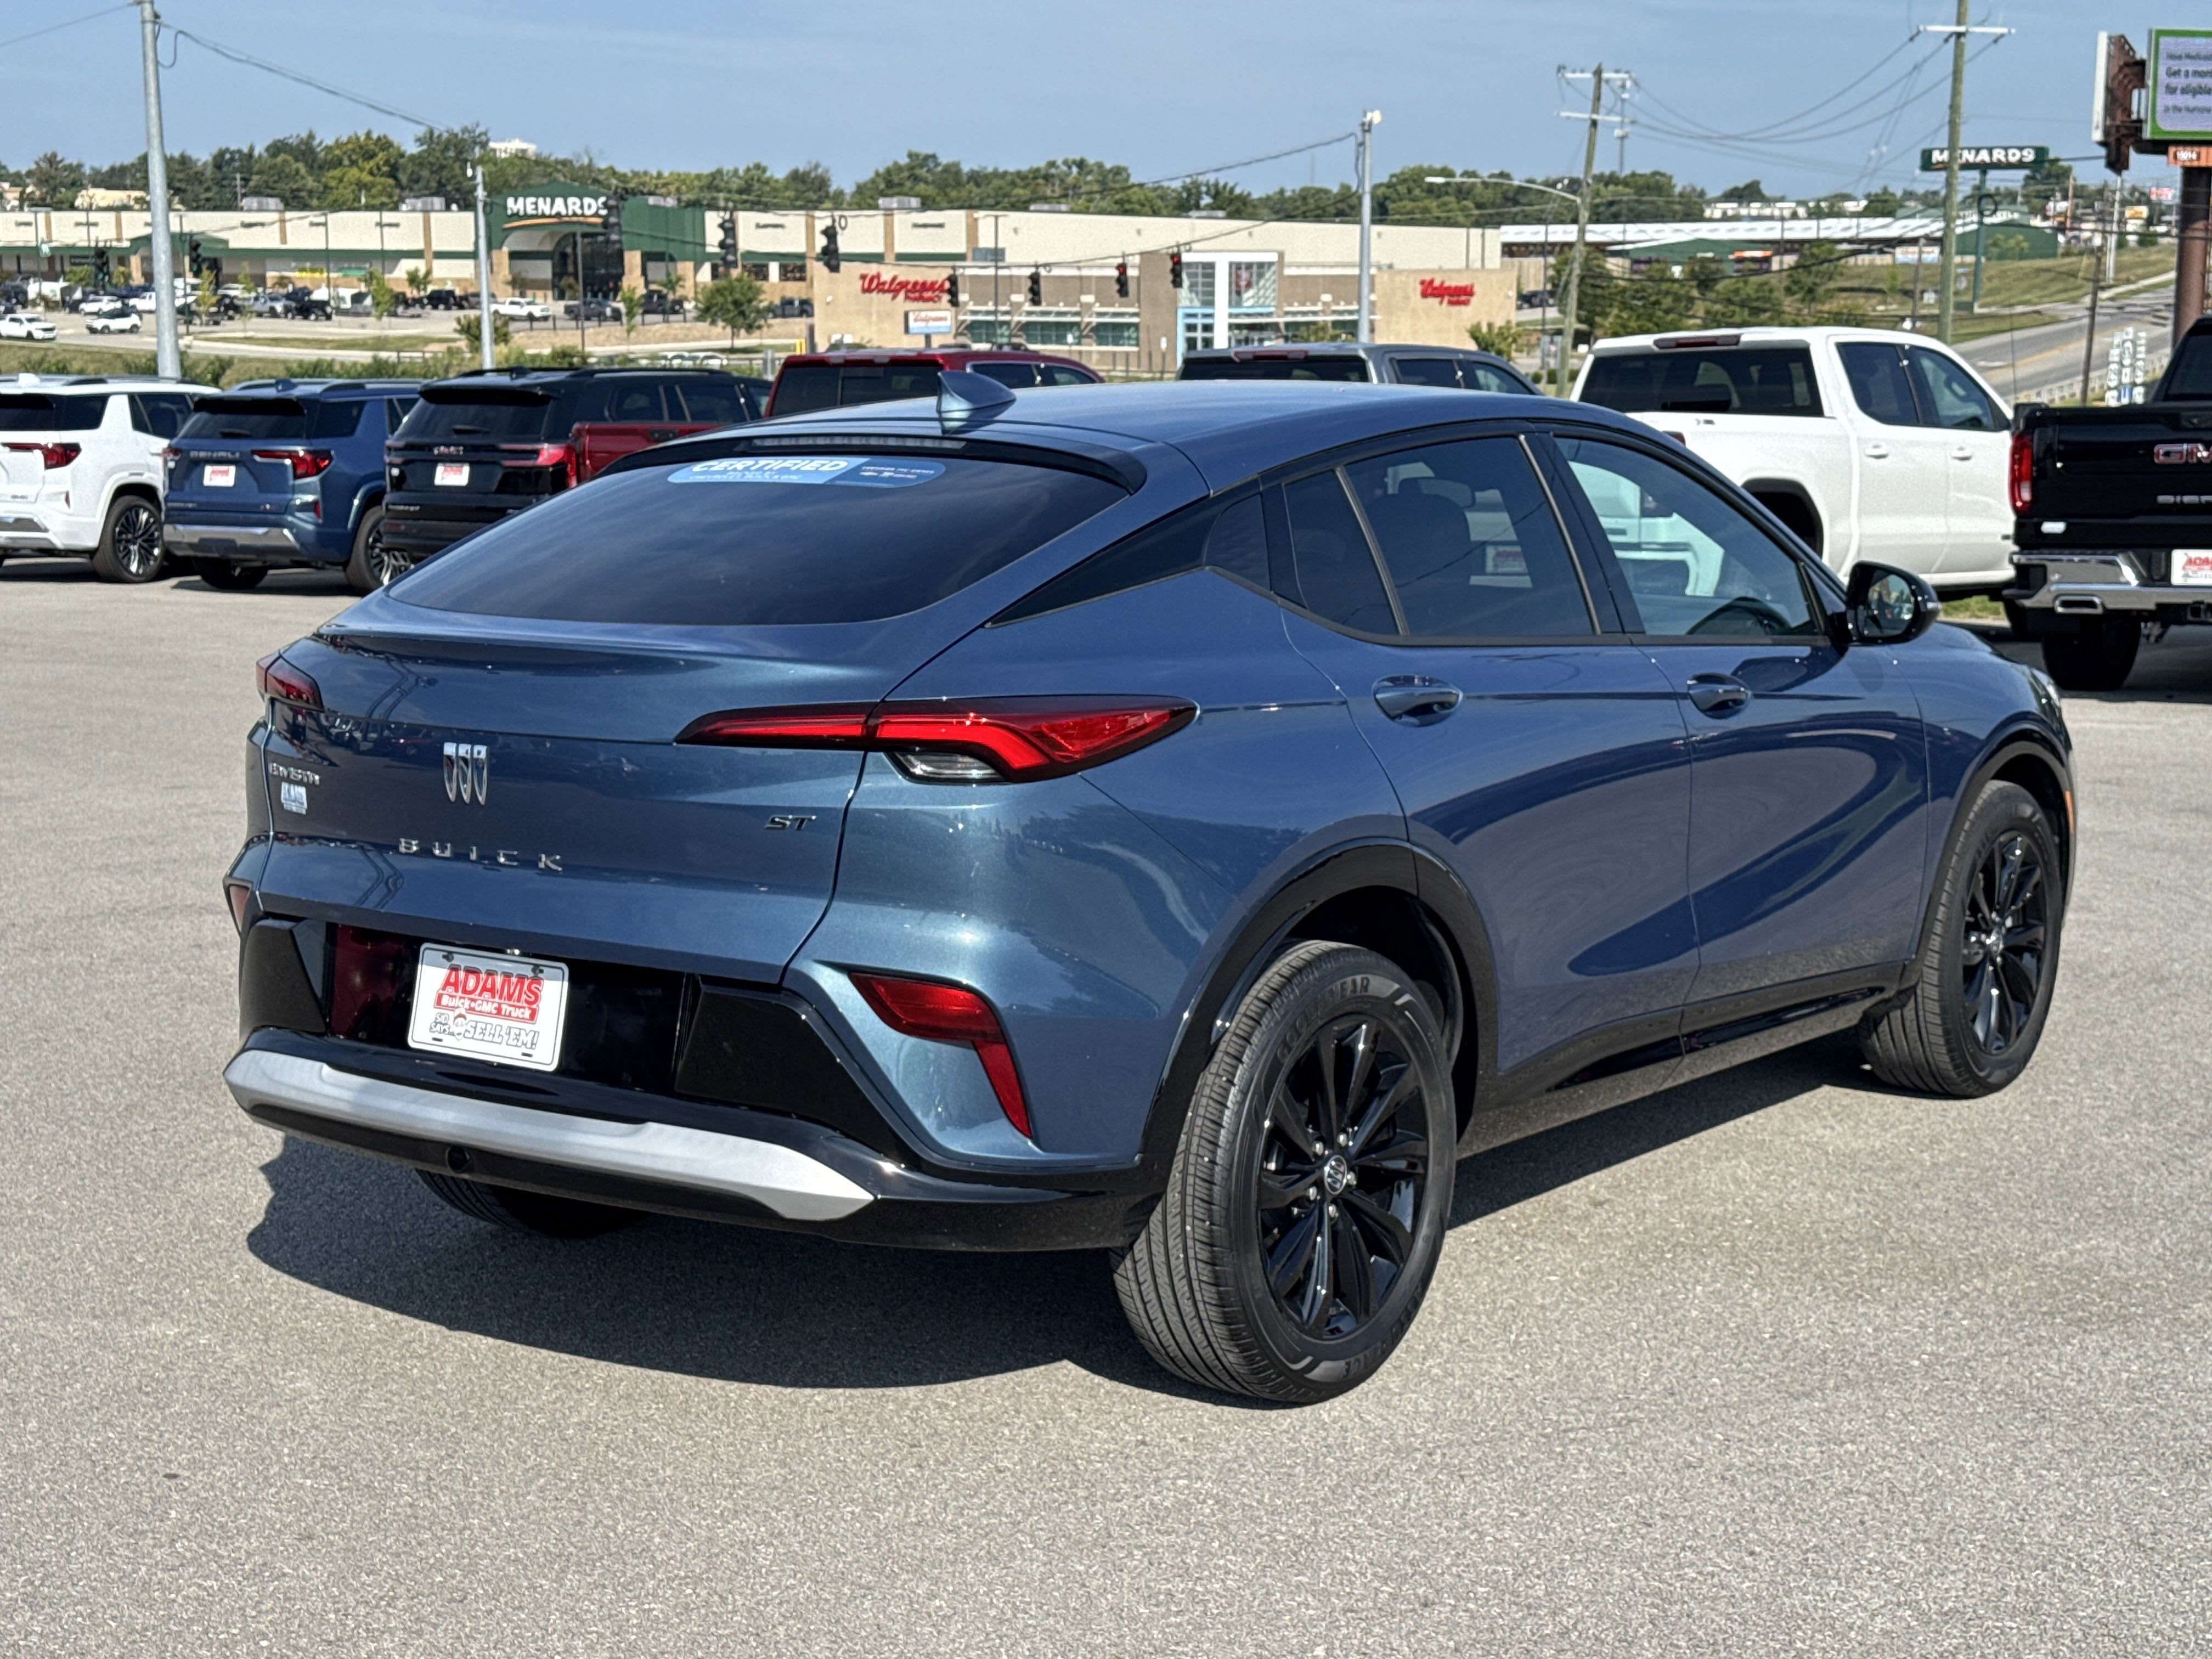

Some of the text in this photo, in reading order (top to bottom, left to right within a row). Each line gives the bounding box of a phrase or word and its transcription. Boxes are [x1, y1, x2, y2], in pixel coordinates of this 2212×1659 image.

[2165, 66, 2181, 78] Get
[506, 196, 608, 216] MENARDS
[860, 272, 949, 301] Walgreens
[692, 460, 849, 472] CERTIFIED
[764, 815, 817, 830] ST
[399, 838, 562, 873] BUICK
[441, 964, 544, 1006] ADAMS
[501, 1004, 532, 1019] Truck
[463, 1020, 504, 1045] SELL
